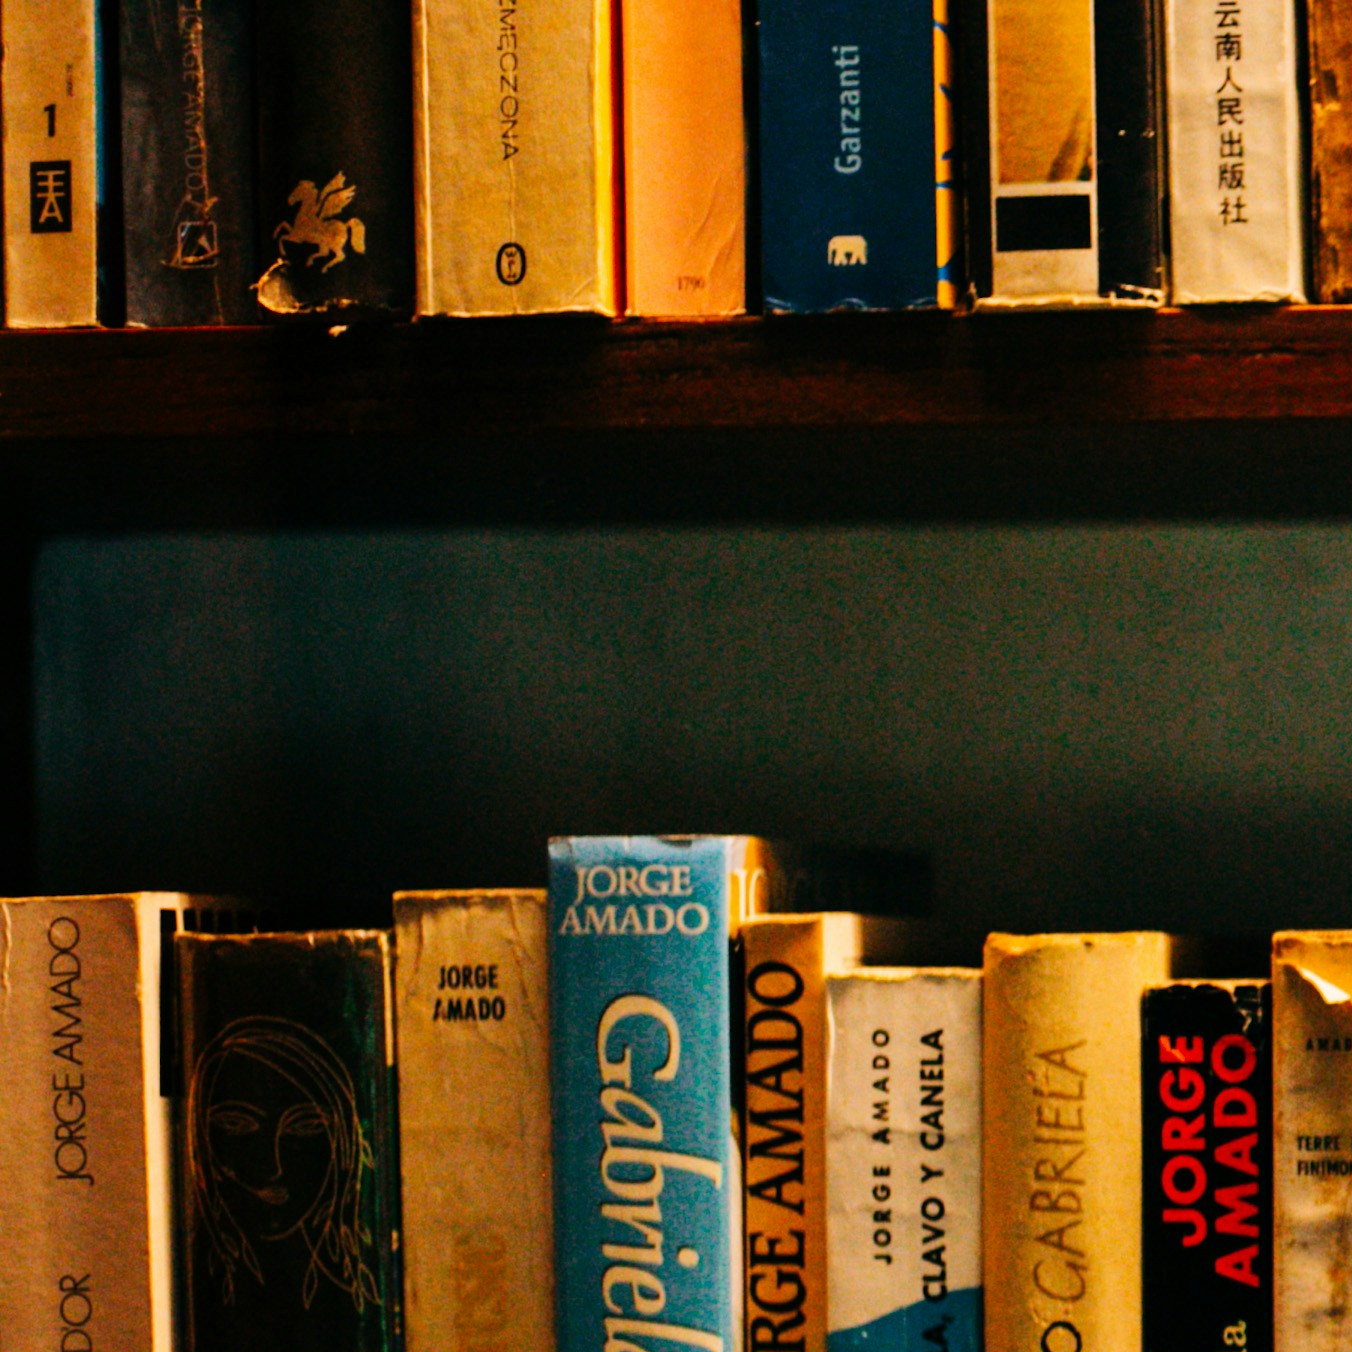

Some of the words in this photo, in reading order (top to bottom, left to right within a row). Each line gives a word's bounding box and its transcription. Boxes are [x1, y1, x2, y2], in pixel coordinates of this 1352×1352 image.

[42, 103, 58, 138] 1
[834, 44, 861, 176] Garzanti
[1214, 0, 1248, 225] 云南人民出版社
[558, 901, 710, 937] AMADO
[574, 864, 693, 905] JORGE
[48, 916, 85, 1067] AMADO
[432, 996, 507, 1023] AMADO
[437, 964, 500, 992] JORGE
[53, 1072, 95, 1187] JORGE
[745, 960, 805, 1215] AMADO
[871, 1029, 891, 1145] AMADO
[919, 1029, 945, 1152] CANELA
[1159, 1034, 1208, 1248] JORGE
[873, 1165, 893, 1265] JORGE
[921, 1166, 945, 1185] Y
[1029, 1039, 1089, 1303] GABRIELA
[1210, 1032, 1261, 1289] AMADO
[921, 1195, 948, 1302] CLAVO
